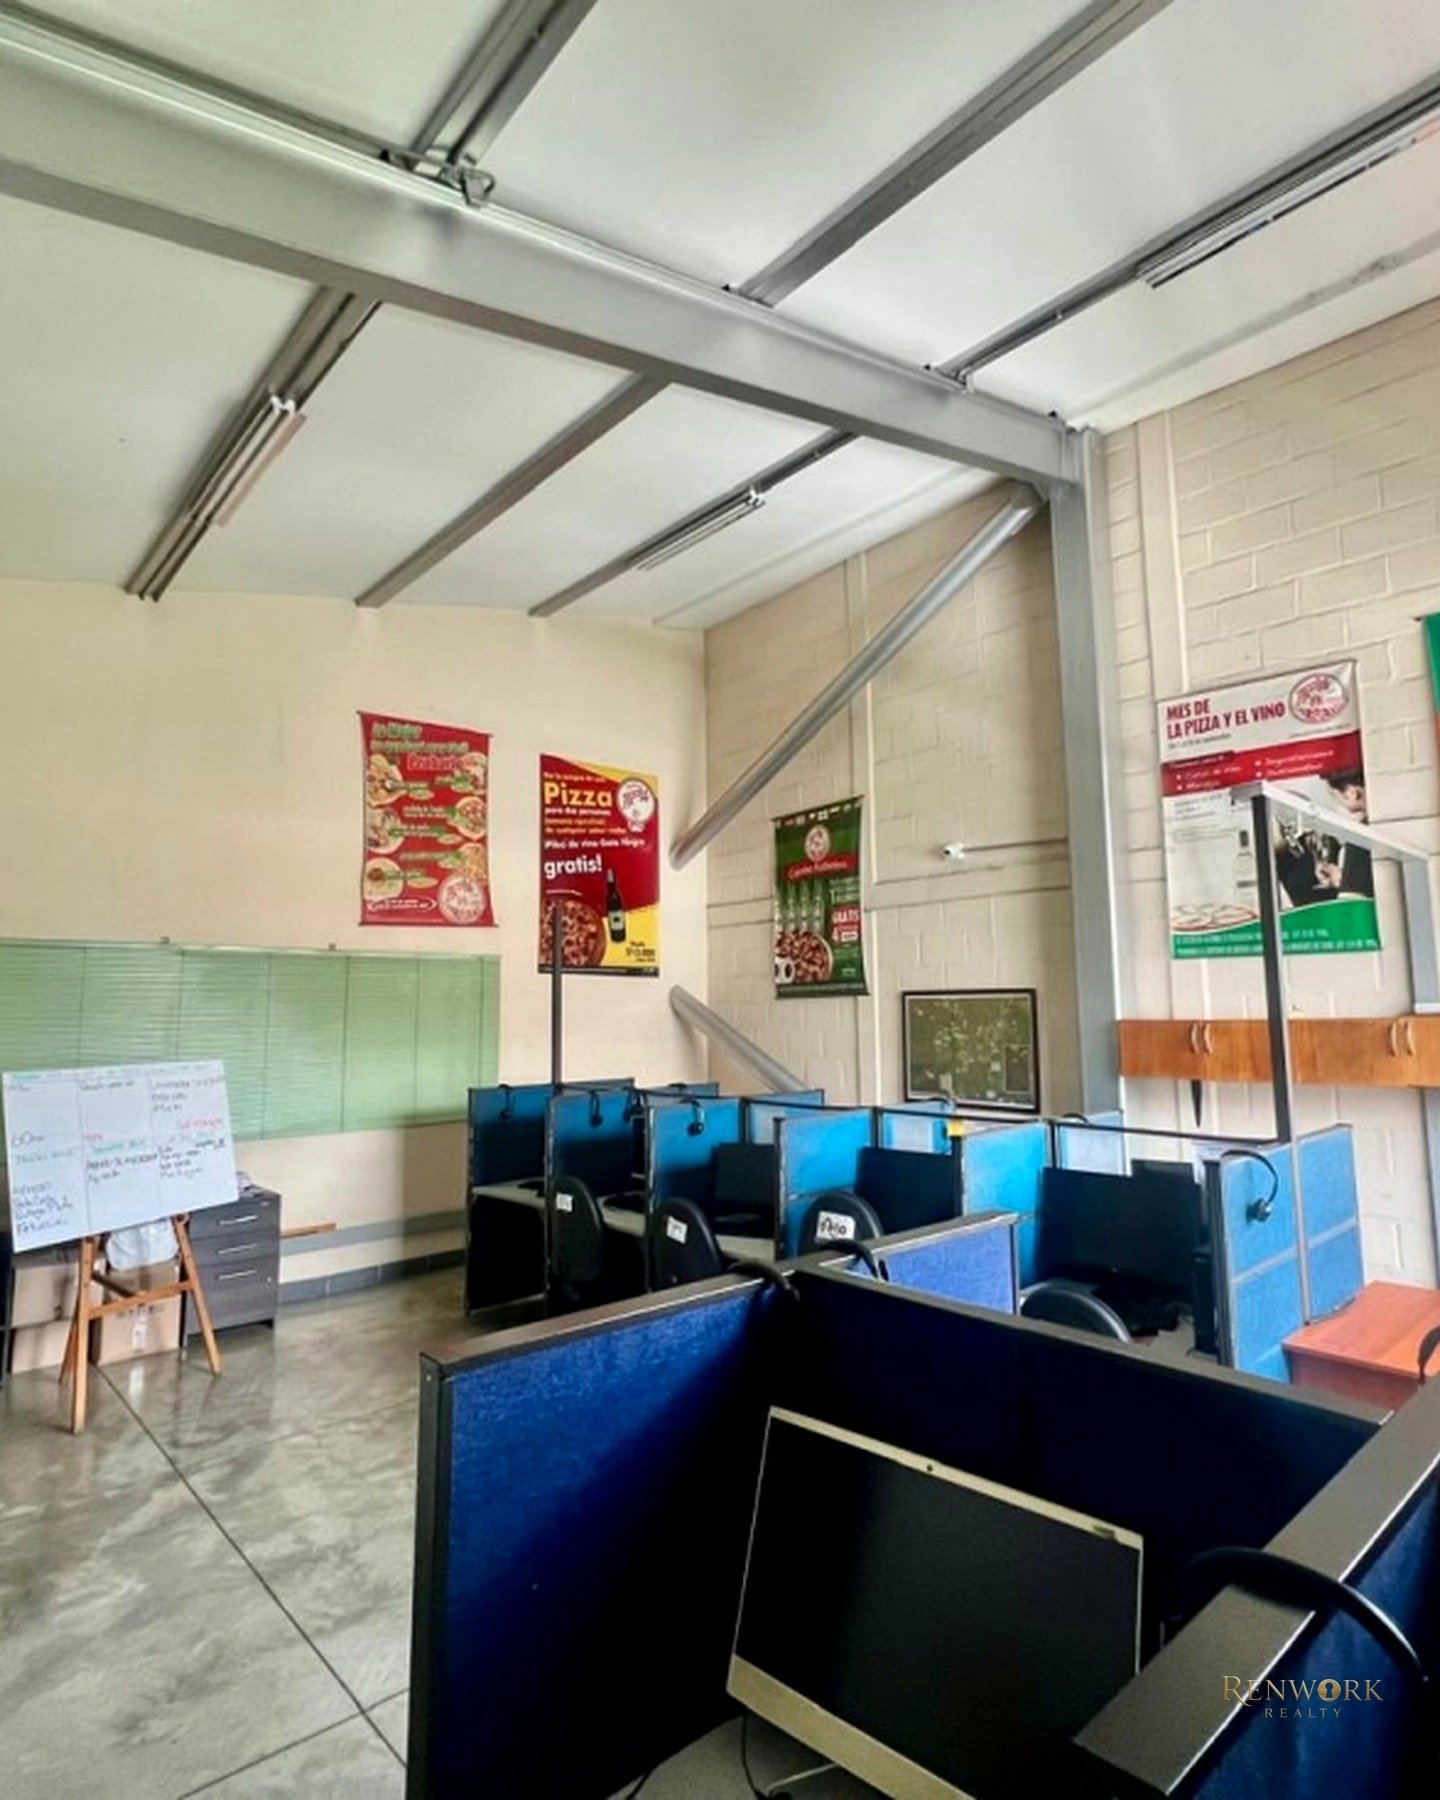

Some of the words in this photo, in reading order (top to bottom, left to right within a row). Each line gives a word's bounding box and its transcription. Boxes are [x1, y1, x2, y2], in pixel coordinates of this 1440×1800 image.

[1167, 701, 1193, 721] MES
[1195, 699, 1211, 717] DE
[1167, 721, 1183, 740] LA
[1185, 715, 1221, 737] PIZZA
[1223, 712, 1232, 728] Y
[1236, 709, 1250, 725] EL
[1252, 701, 1286, 722] VINO
[543, 781, 613, 807] Pizza
[543, 854, 603, 880] gratis!
